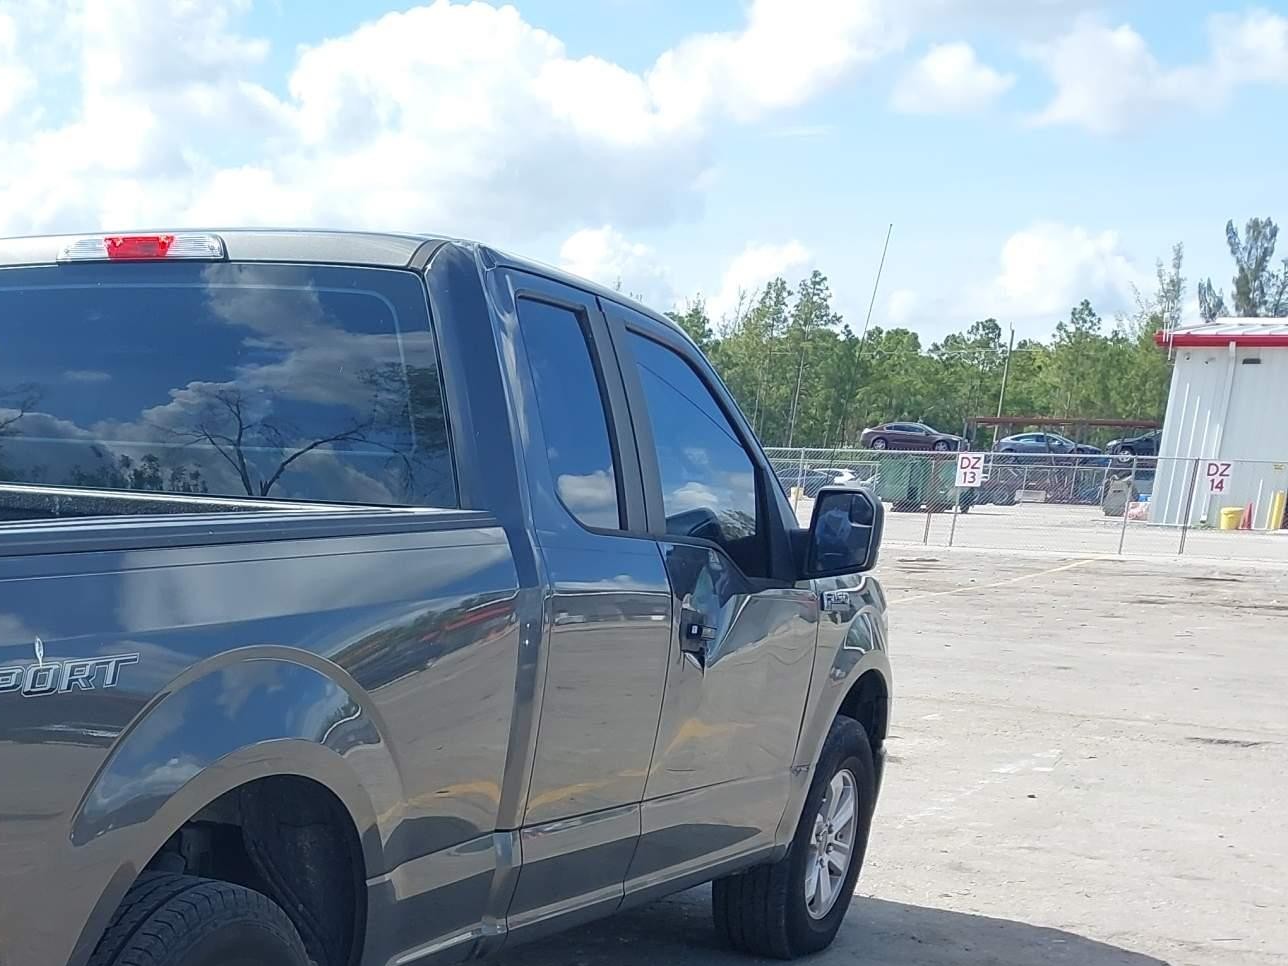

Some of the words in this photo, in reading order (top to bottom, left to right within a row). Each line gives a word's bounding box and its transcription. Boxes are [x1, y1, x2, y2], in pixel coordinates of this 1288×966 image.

[960, 456, 981, 470] DZ
[1207, 463, 1231, 477] DZ
[963, 471, 976, 484] 13
[1210, 478, 1224, 492] 14
